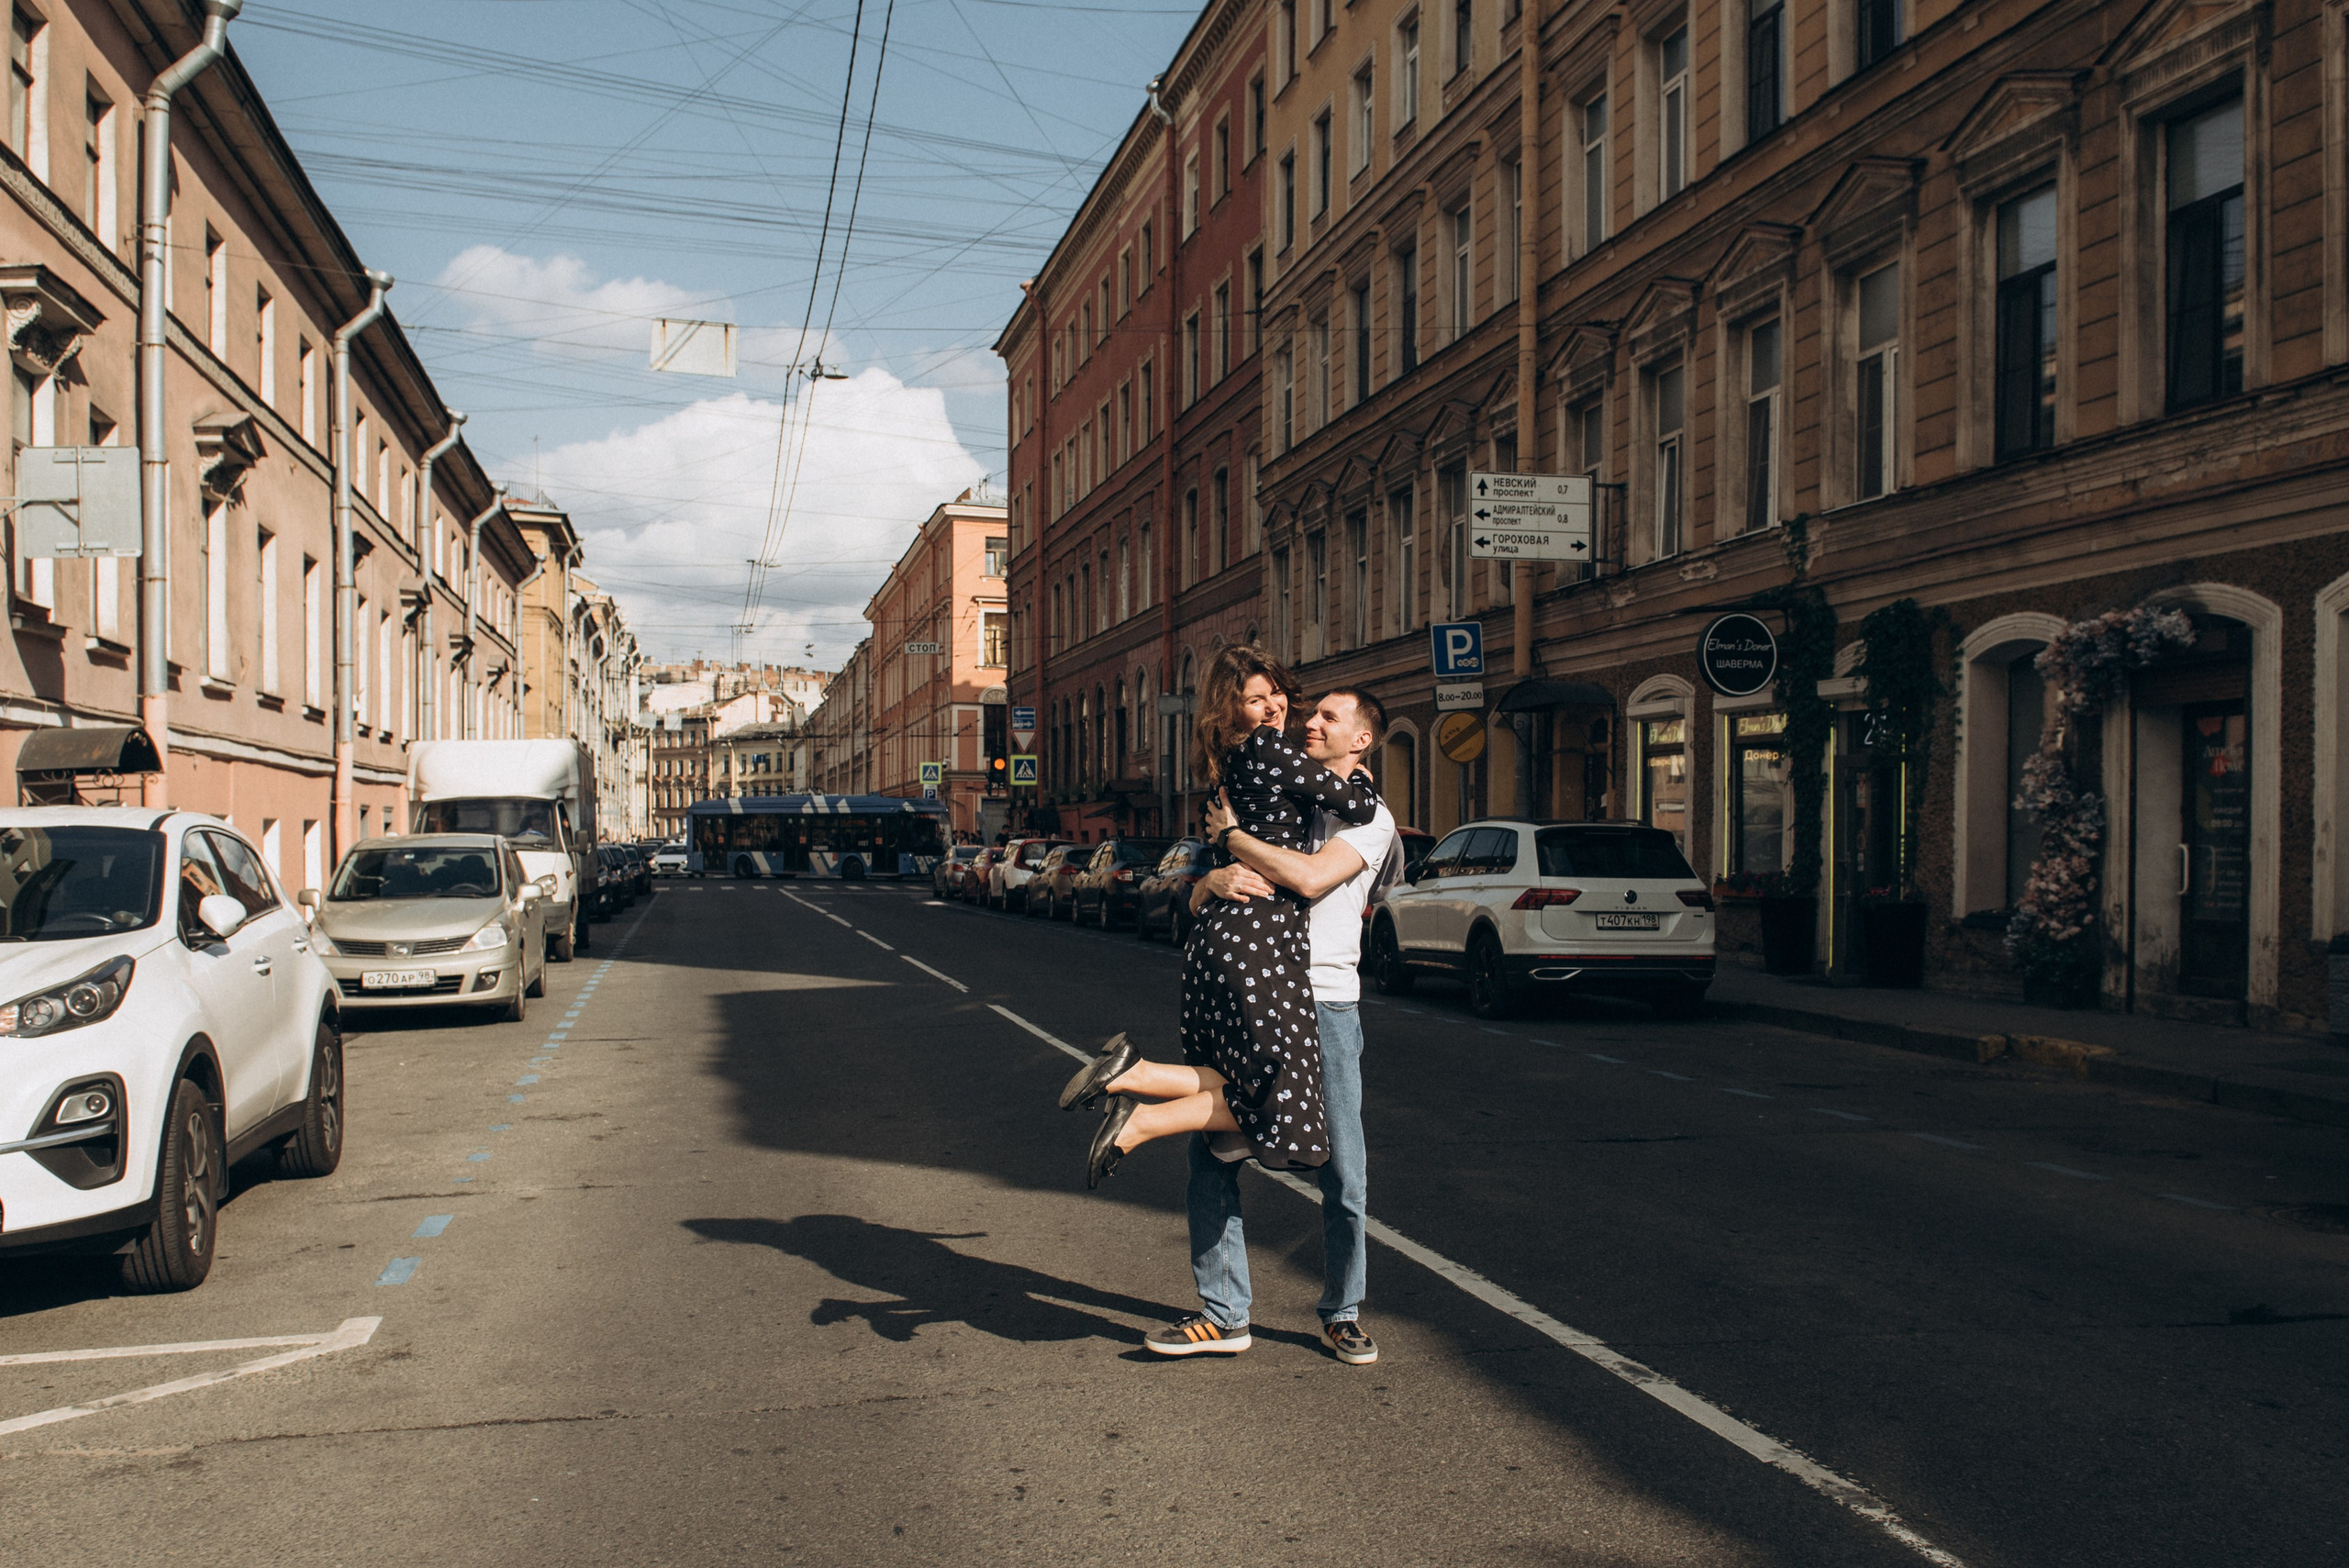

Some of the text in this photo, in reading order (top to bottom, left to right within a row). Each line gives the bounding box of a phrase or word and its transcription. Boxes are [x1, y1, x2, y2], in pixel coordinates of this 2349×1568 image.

[1493, 477, 1537, 488] НЕВСКИЙ
[1493, 488, 1534, 497] проспект
[1557, 485, 1568, 495] 0,7
[1493, 505, 1555, 516] АДМИРАЛТЕЙСКИЙ
[1492, 517, 1521, 526] проспект
[1557, 514, 1568, 523] 0,8
[1492, 534, 1549, 545] ГОРОХОВАЯ
[1493, 546, 1519, 554] улица
[908, 643, 937, 652] СТОП
[1742, 639, 1772, 651] Doner
[1716, 659, 1764, 669] ШАВЕРМА
